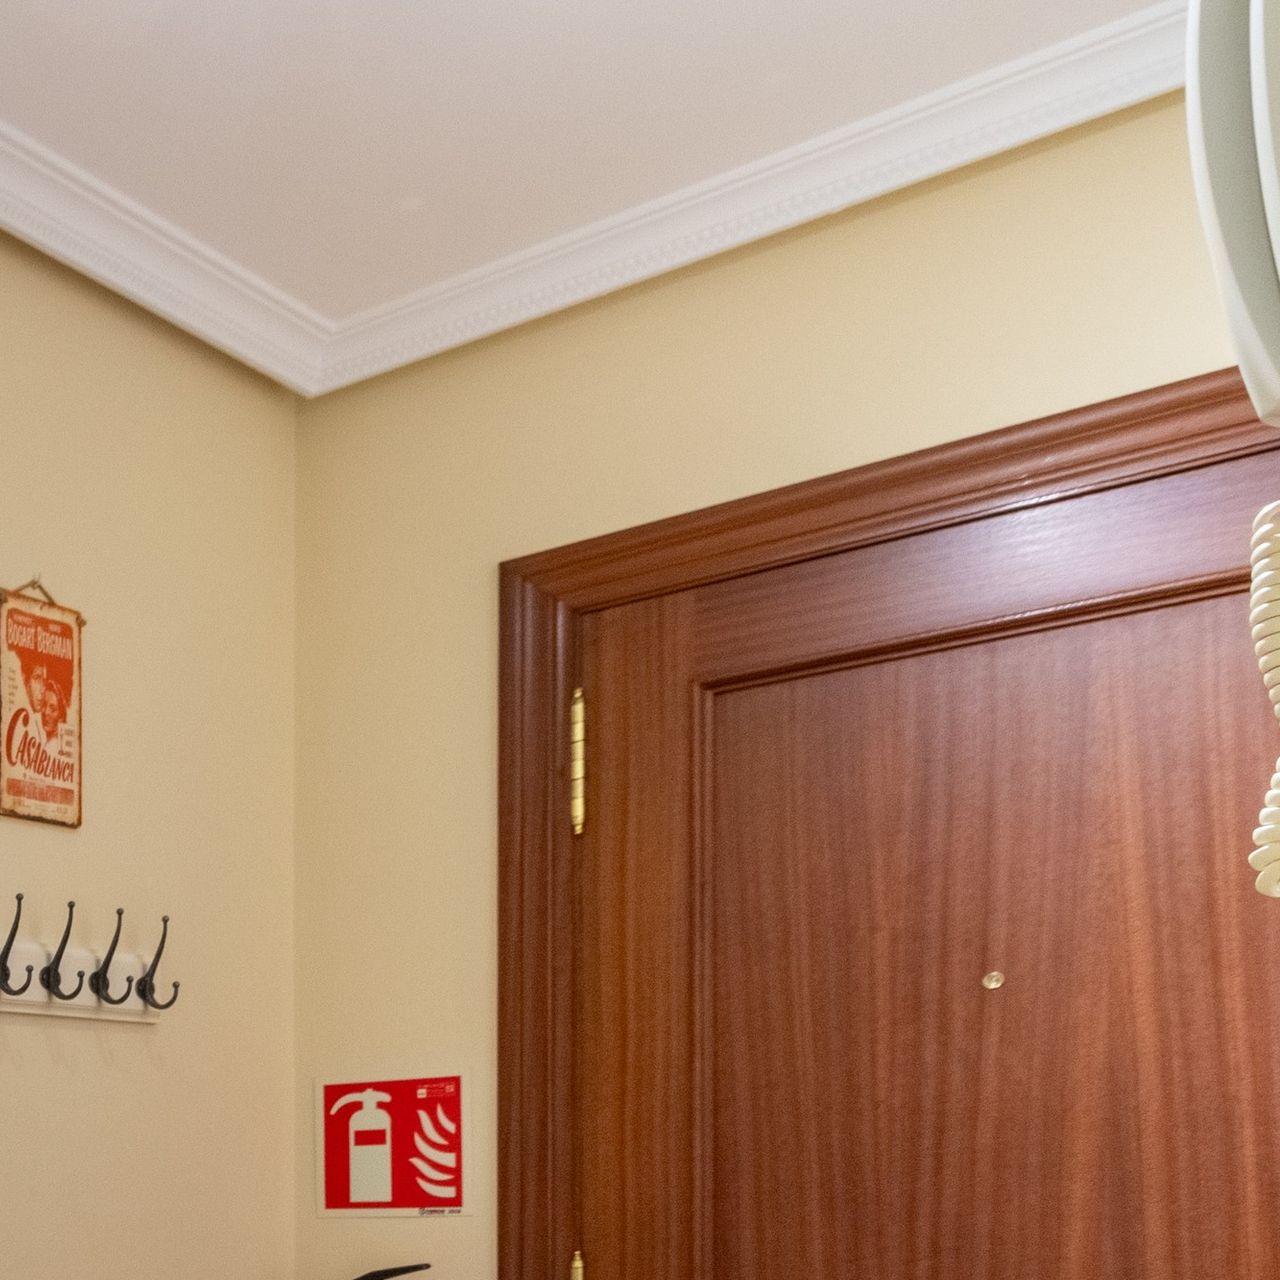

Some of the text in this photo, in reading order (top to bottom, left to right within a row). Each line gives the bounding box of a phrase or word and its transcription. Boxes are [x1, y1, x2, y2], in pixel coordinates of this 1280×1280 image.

[7, 617, 72, 660] BOGART BERGMAN
[5, 707, 75, 784] CASABLANCA
